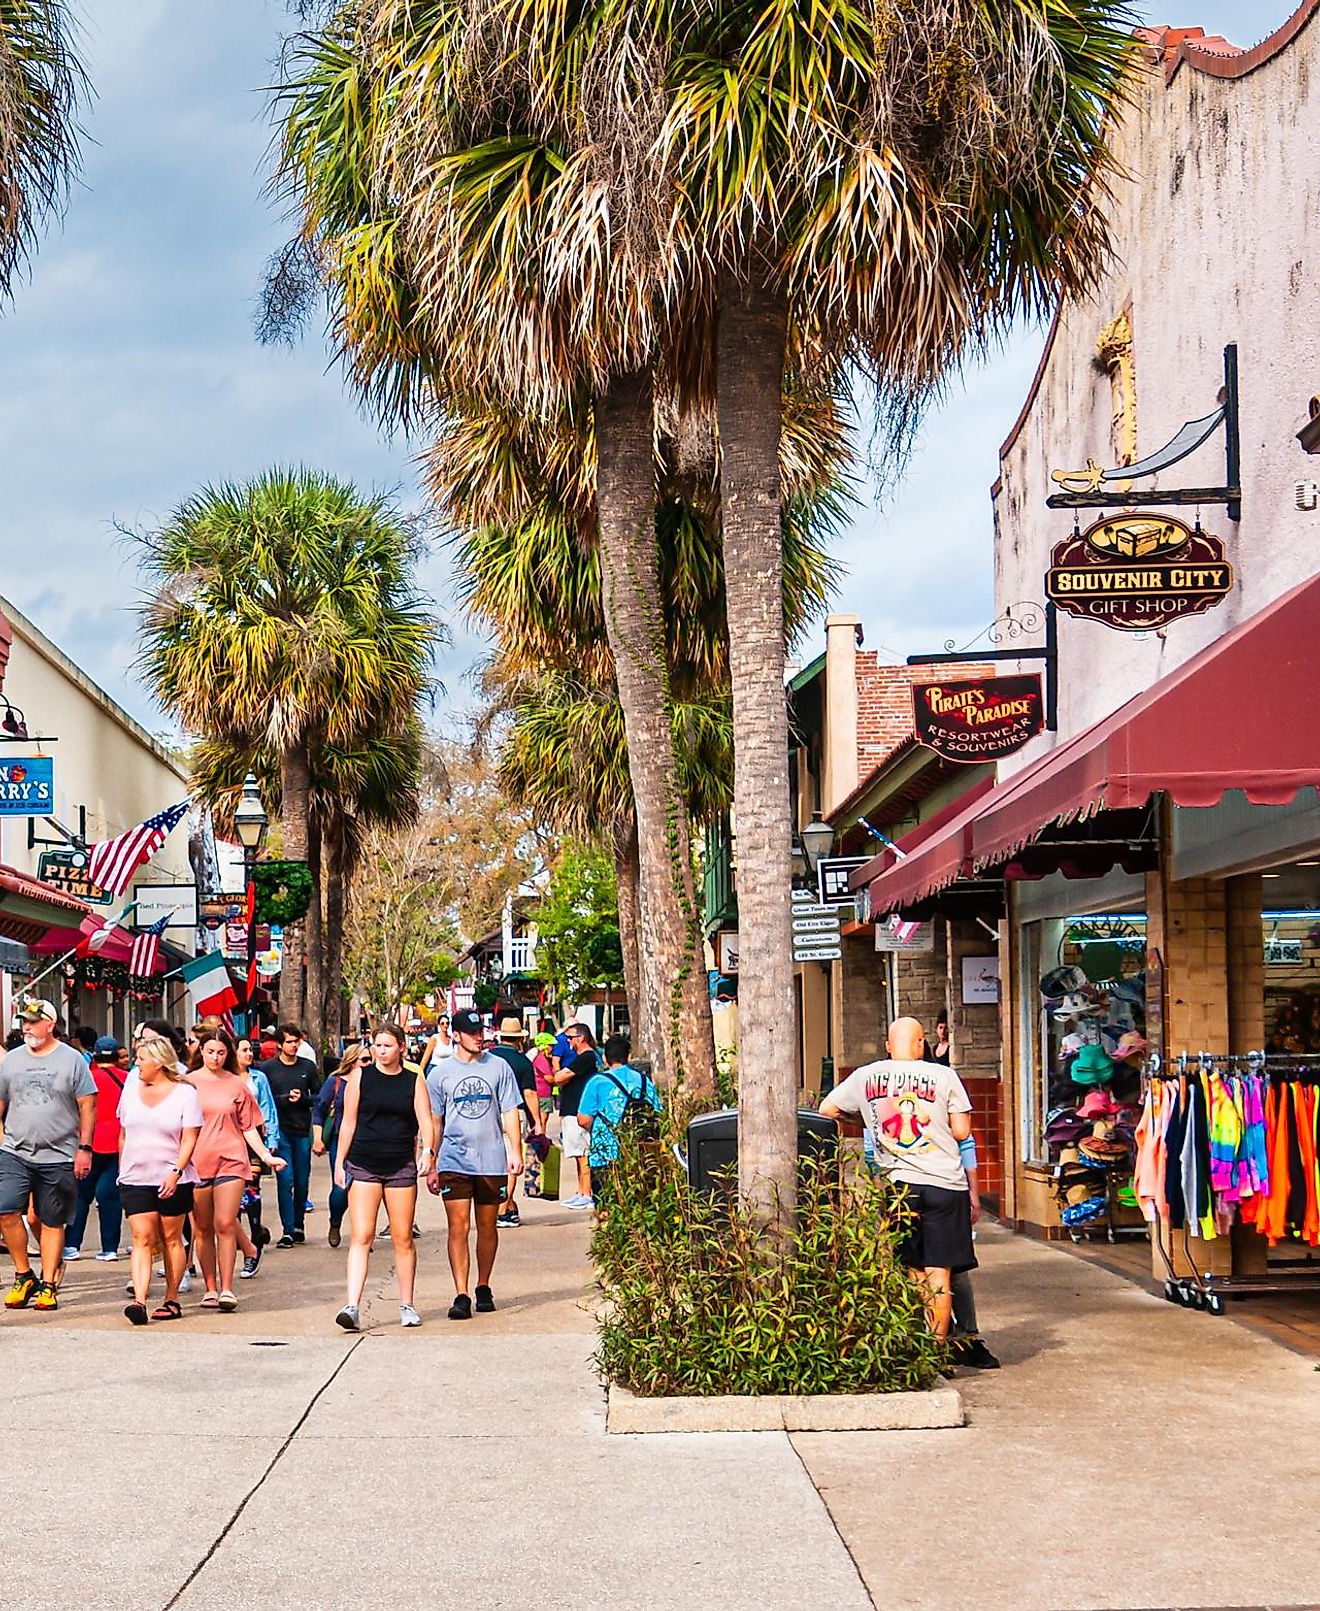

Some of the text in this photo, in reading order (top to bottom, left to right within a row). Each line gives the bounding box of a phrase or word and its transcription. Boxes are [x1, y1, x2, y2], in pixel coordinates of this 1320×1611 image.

[1057, 570, 1224, 591] SOUVENIR CITY
[1089, 598, 1188, 615] GIFT SHOP
[925, 686, 985, 714] PIRATE'S
[961, 700, 1032, 726] PARADISE
[927, 717, 1032, 742] RESORTWEAR
[932, 731, 1029, 752] & SOUVENIRS
[44, 864, 89, 881] PIZZ
[47, 879, 103, 897] TIME
